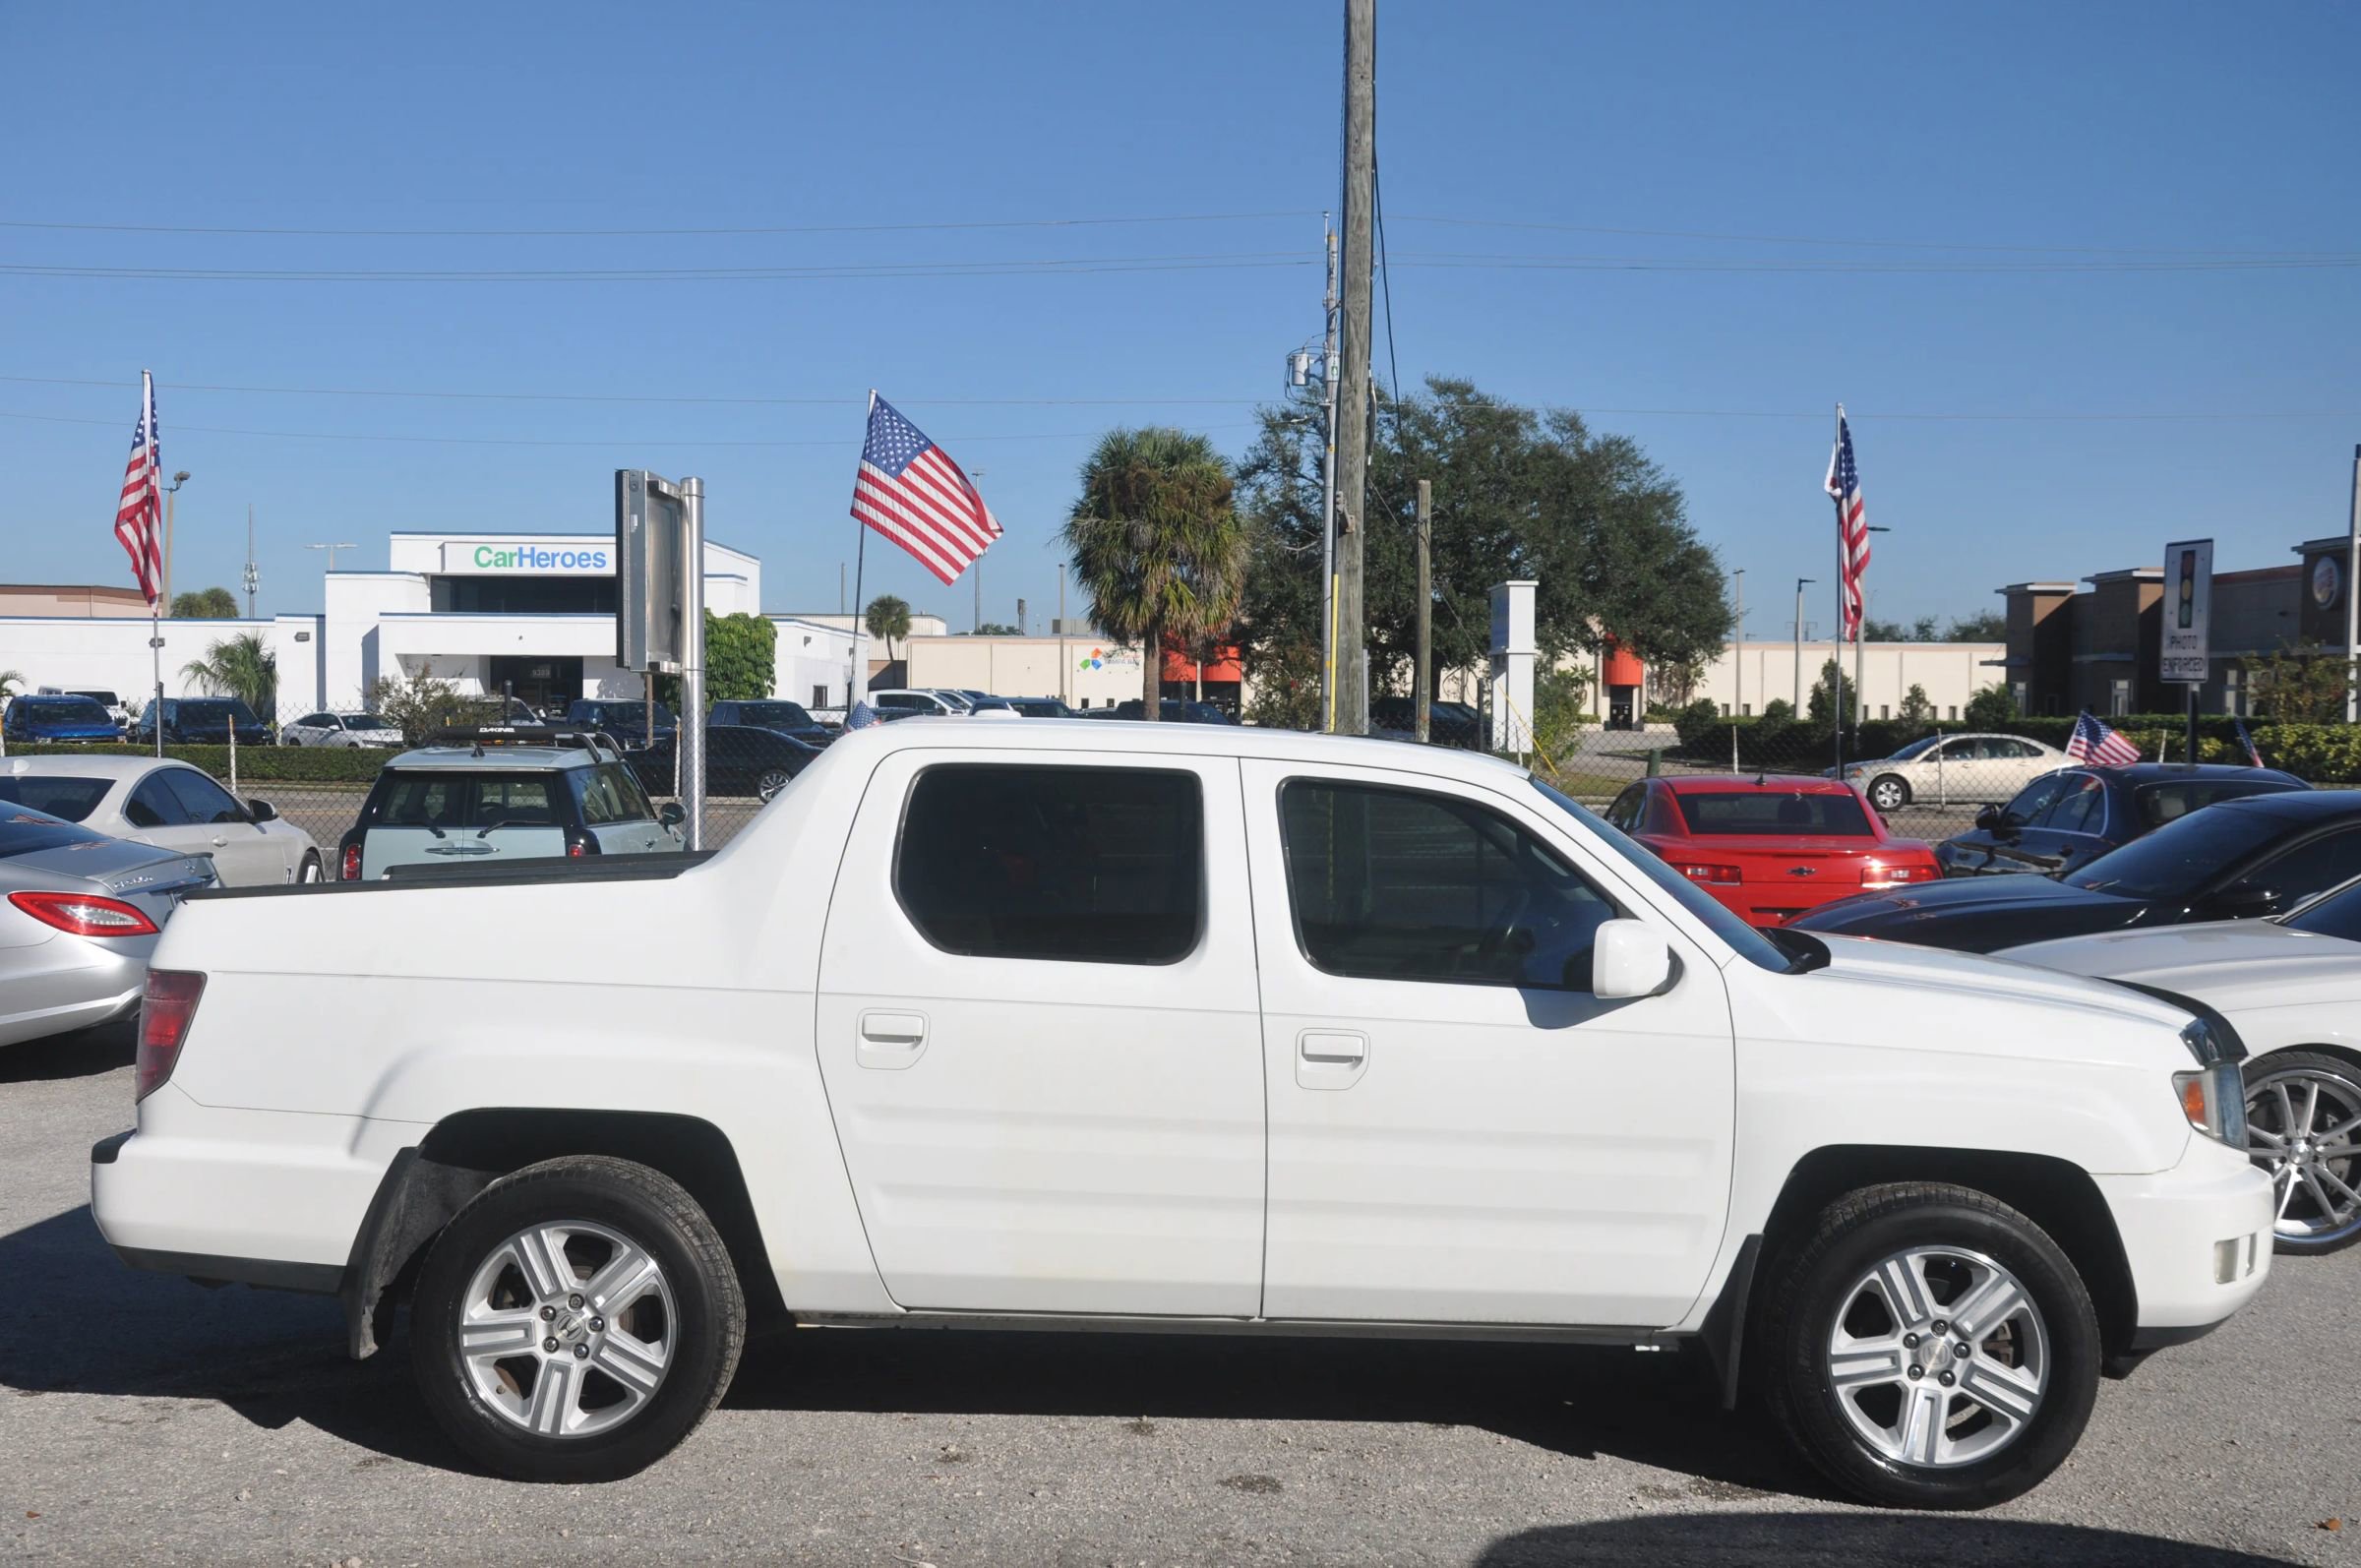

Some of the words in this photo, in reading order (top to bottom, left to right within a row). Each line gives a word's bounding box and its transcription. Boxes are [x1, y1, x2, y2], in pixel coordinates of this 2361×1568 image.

[474, 546, 607, 568] CarHeroes
[2170, 634, 2197, 649] PHOTO
[2163, 657, 2203, 671] ENFORCED
